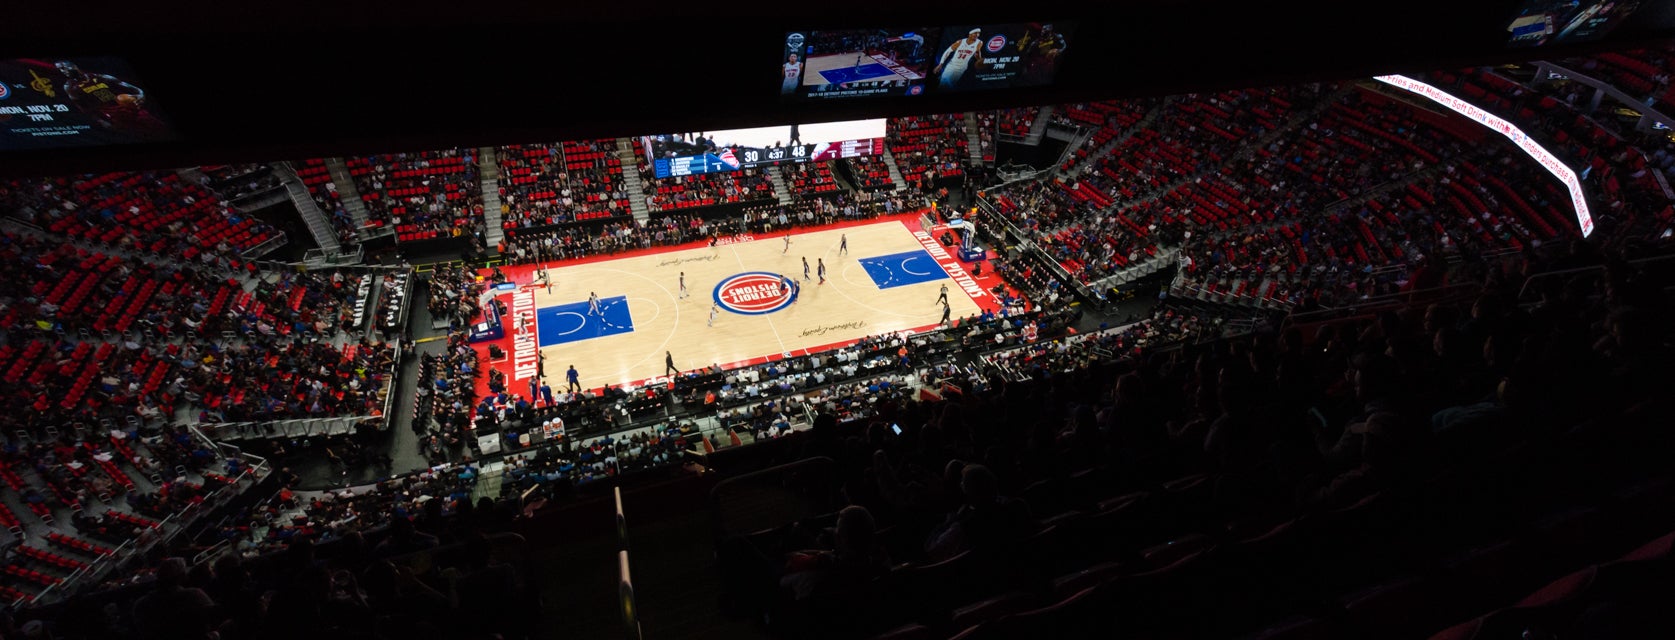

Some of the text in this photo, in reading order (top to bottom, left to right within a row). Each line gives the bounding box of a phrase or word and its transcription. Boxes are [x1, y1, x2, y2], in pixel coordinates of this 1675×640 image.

[0, 104, 69, 115] MON, NOV. 20
[1387, 75, 1407, 87] Fries
[1408, 82, 1425, 93] and
[1426, 87, 1451, 105] Medium
[1452, 99, 1467, 113] Soft
[1467, 106, 1487, 123] Drink
[1487, 117, 1505, 131] with
[26, 114, 54, 122] 7PM
[744, 146, 806, 163] 30 4:37 48
[913, 231, 988, 298] DETROIT PISTONS
[728, 282, 778, 297] PISTONS
[732, 289, 781, 303] DETROIT
[512, 288, 538, 381] DETROIT PISTON
